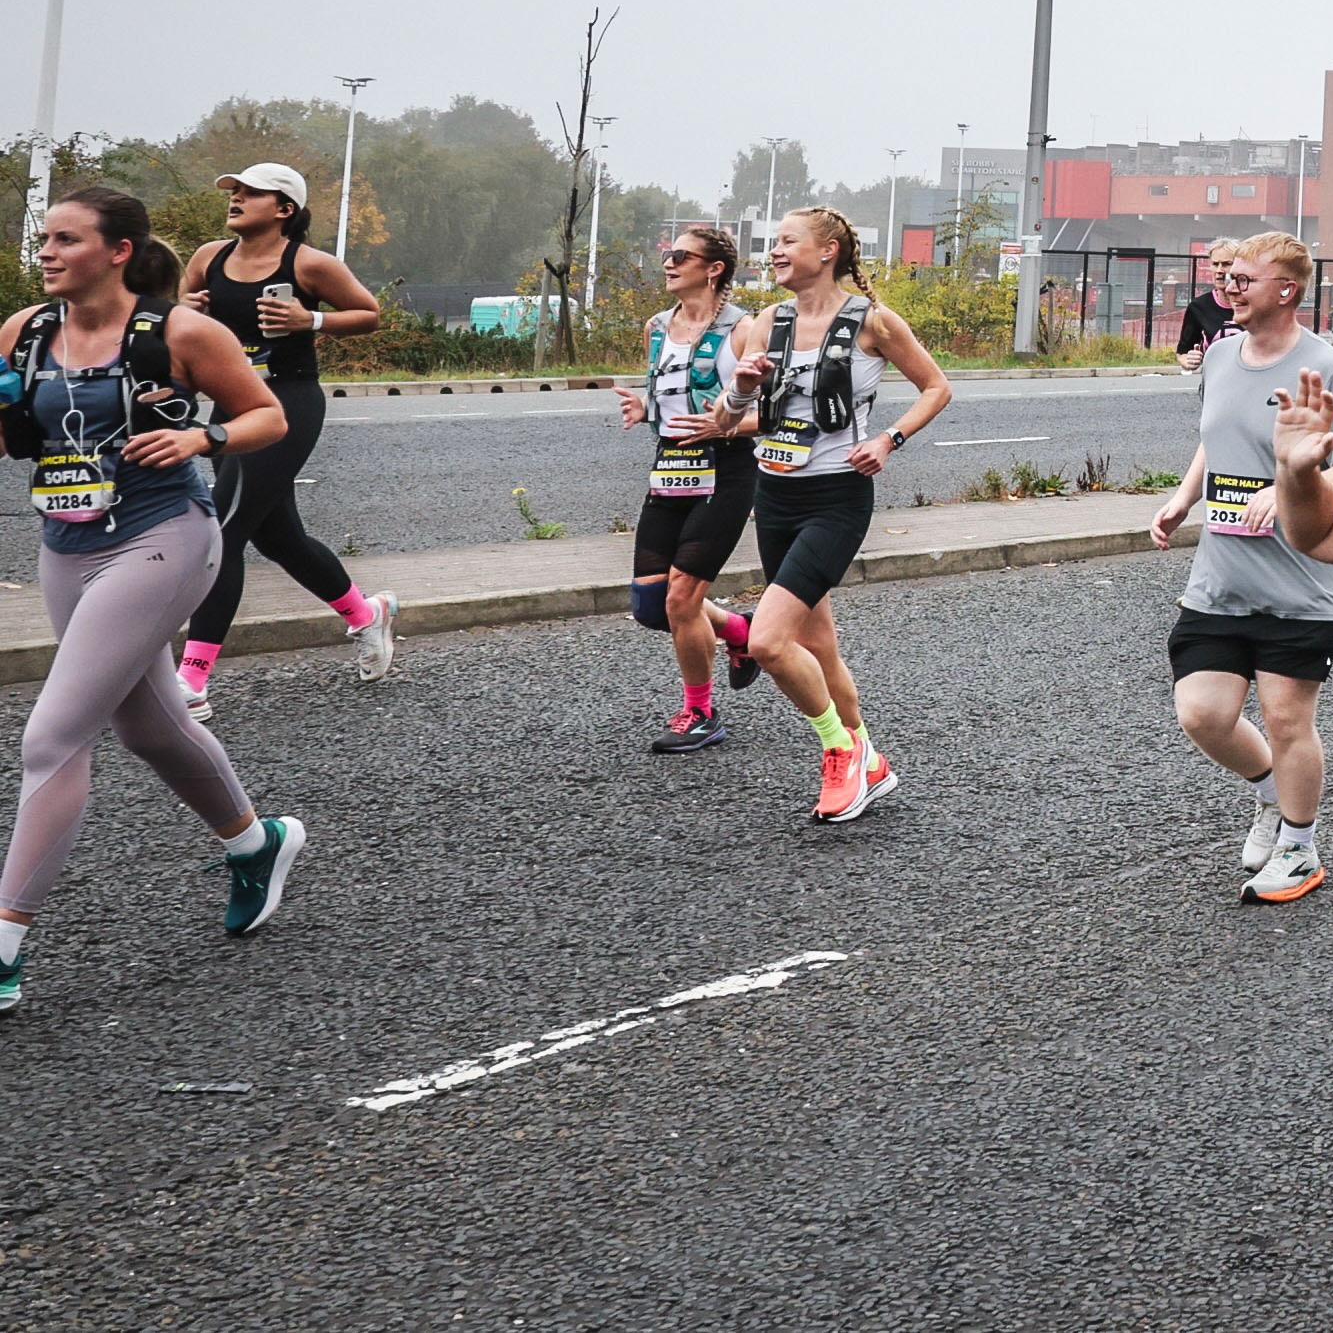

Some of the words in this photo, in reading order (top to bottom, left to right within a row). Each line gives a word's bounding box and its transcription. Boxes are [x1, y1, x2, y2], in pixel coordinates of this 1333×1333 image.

[951, 167, 996, 175] CARLTON
[784, 420, 809, 429] HALF
[761, 448, 793, 463] 23135
[656, 459, 709, 469] DANIELLE
[44, 469, 91, 484] SOFIA
[660, 476, 700, 487] 19269
[1220, 477, 1239, 486] MCR
[1239, 479, 1265, 488] HALF
[46, 494, 92, 510] 21284
[1210, 509, 1242, 523] 203
